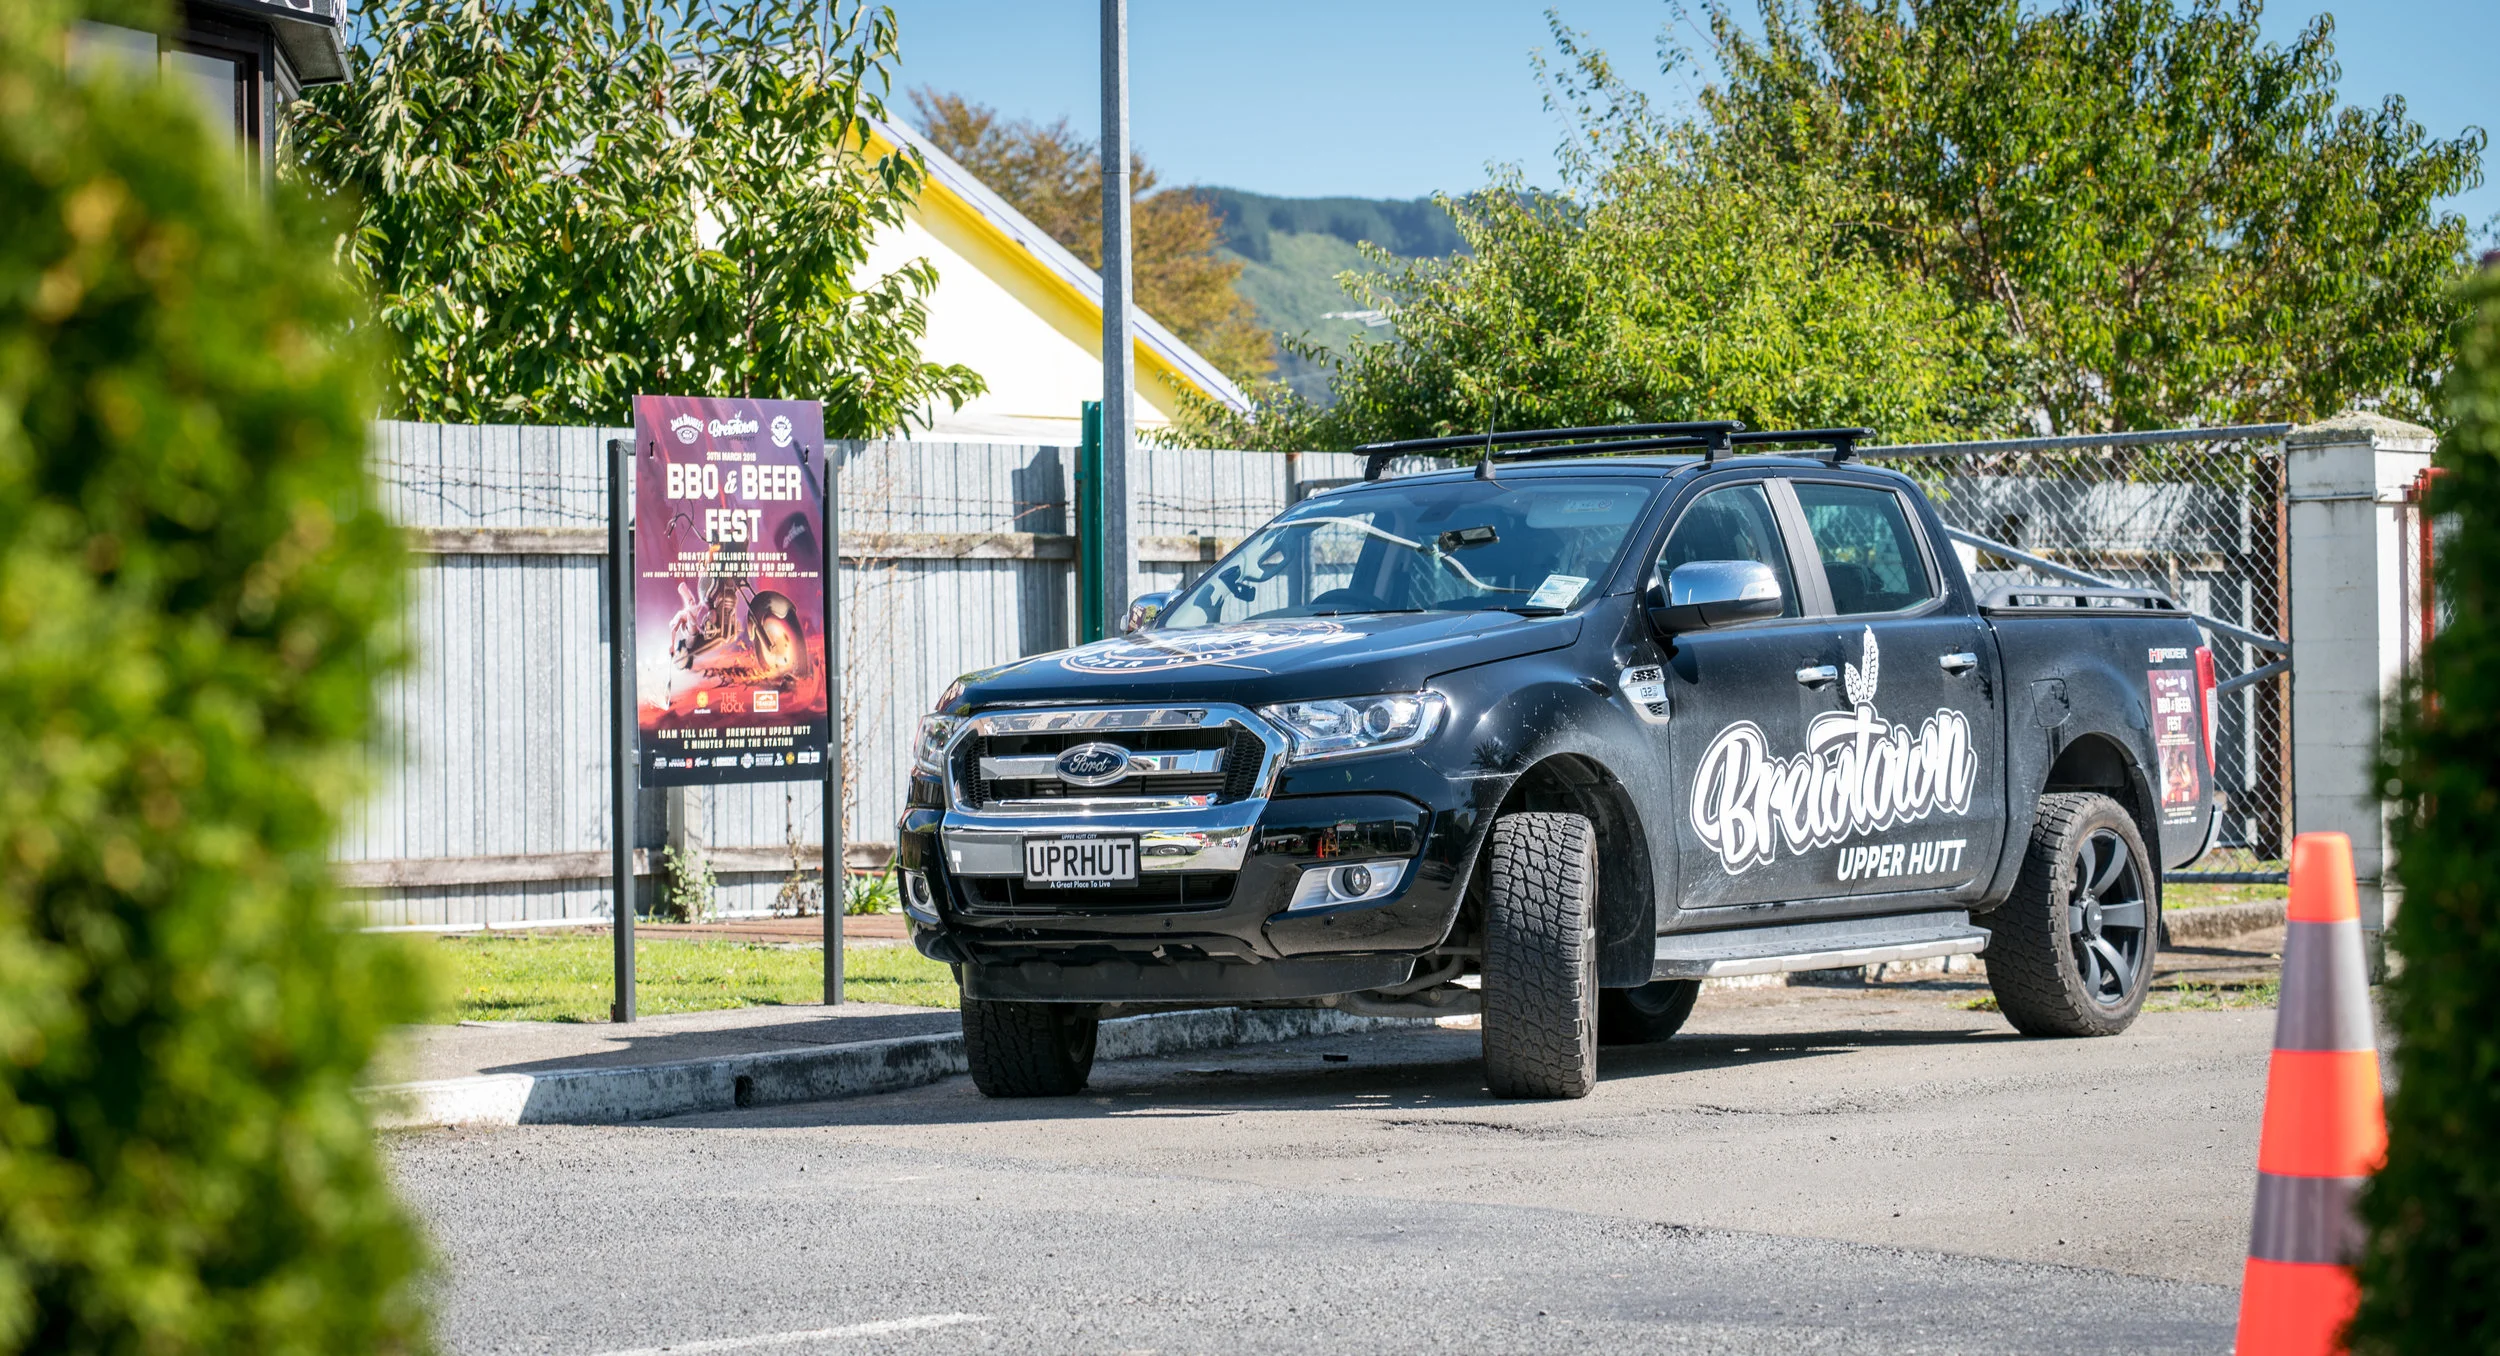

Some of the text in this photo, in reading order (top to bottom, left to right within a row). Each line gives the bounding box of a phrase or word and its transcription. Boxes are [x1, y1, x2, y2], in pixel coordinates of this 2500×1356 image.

[708, 418, 759, 438] Brewtown
[722, 452, 742, 462] MARCH
[724, 470, 738, 494] &
[741, 464, 802, 500] BEER
[705, 508, 762, 543] FEST
[678, 552, 787, 561] GREATER WELLINGTON REGION'S
[668, 563, 705, 572] ULTIMATE
[706, 563, 722, 572] LOW
[725, 563, 739, 572] AND
[740, 563, 759, 572] SLOW
[777, 563, 795, 572] COMP
[721, 692, 737, 703] THE
[721, 702, 746, 713] ROCK
[658, 725, 811, 739] 10AM TILL LATE BREWTOWN UPPER HUTT
[691, 739, 723, 750] MINUTES
[725, 738, 745, 748] FROM
[748, 738, 761, 748] THE
[763, 737, 793, 747] STATION
[1069, 752, 1109, 773] Ford
[1691, 702, 1977, 874] Brewtown
[1029, 844, 1131, 877] UPRHUT
[1837, 839, 1967, 881] UPPER HUTT
[1099, 880, 1111, 888] Live
